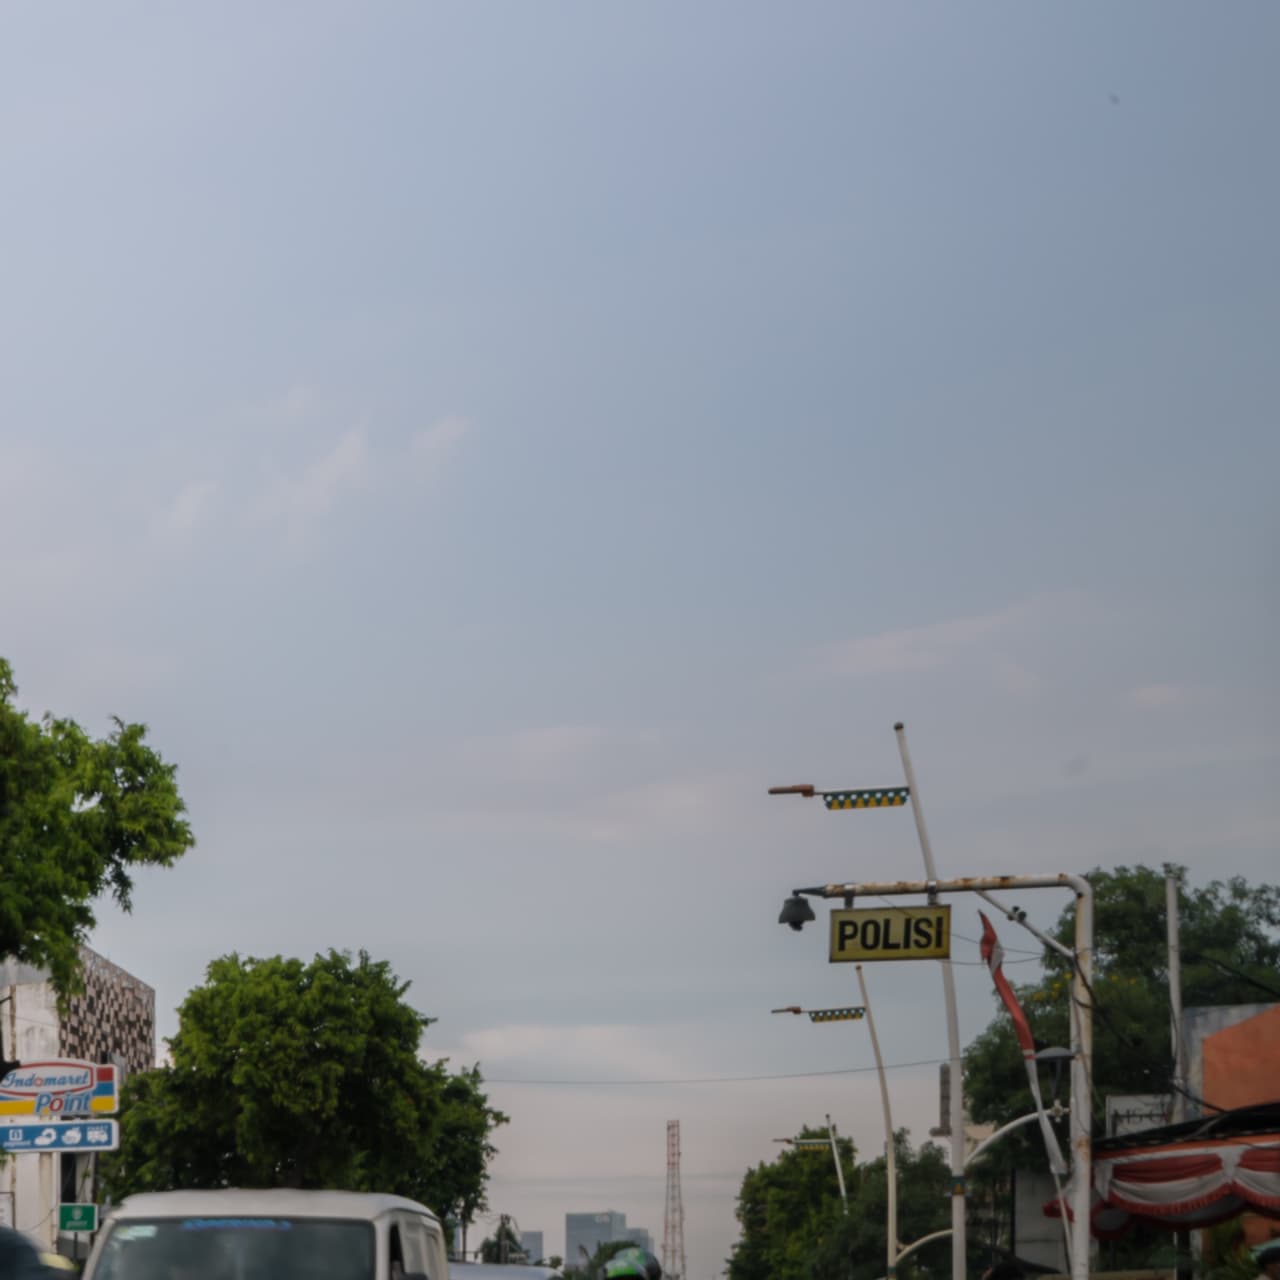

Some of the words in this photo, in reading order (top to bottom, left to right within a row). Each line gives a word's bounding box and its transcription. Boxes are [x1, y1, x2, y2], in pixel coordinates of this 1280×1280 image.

[838, 916, 944, 952] POLISI
[1, 1071, 89, 1089] Indomaret
[36, 1092, 92, 1115] Point
